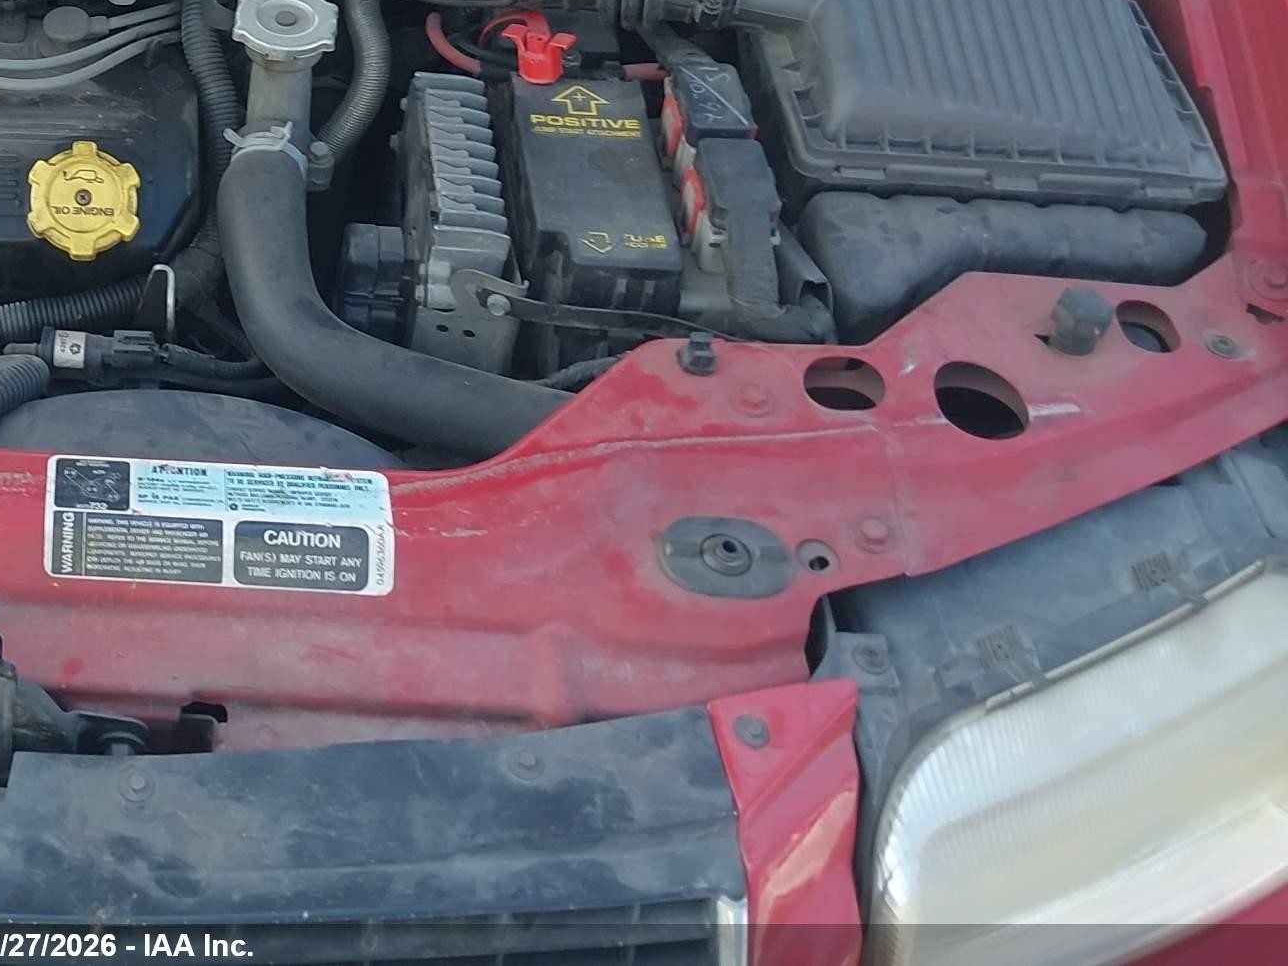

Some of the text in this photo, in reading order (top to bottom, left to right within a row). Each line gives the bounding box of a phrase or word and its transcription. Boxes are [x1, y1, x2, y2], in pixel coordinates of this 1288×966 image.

[530, 113, 641, 130] POSITIVE
[52, 205, 114, 217] ENGINE OIL
[61, 512, 75, 573] WARNING
[263, 529, 341, 549] CAUTION
[240, 551, 363, 568] FAN(S) MAY START ANY
[247, 566, 357, 583] TIME IGNITION IS ON
